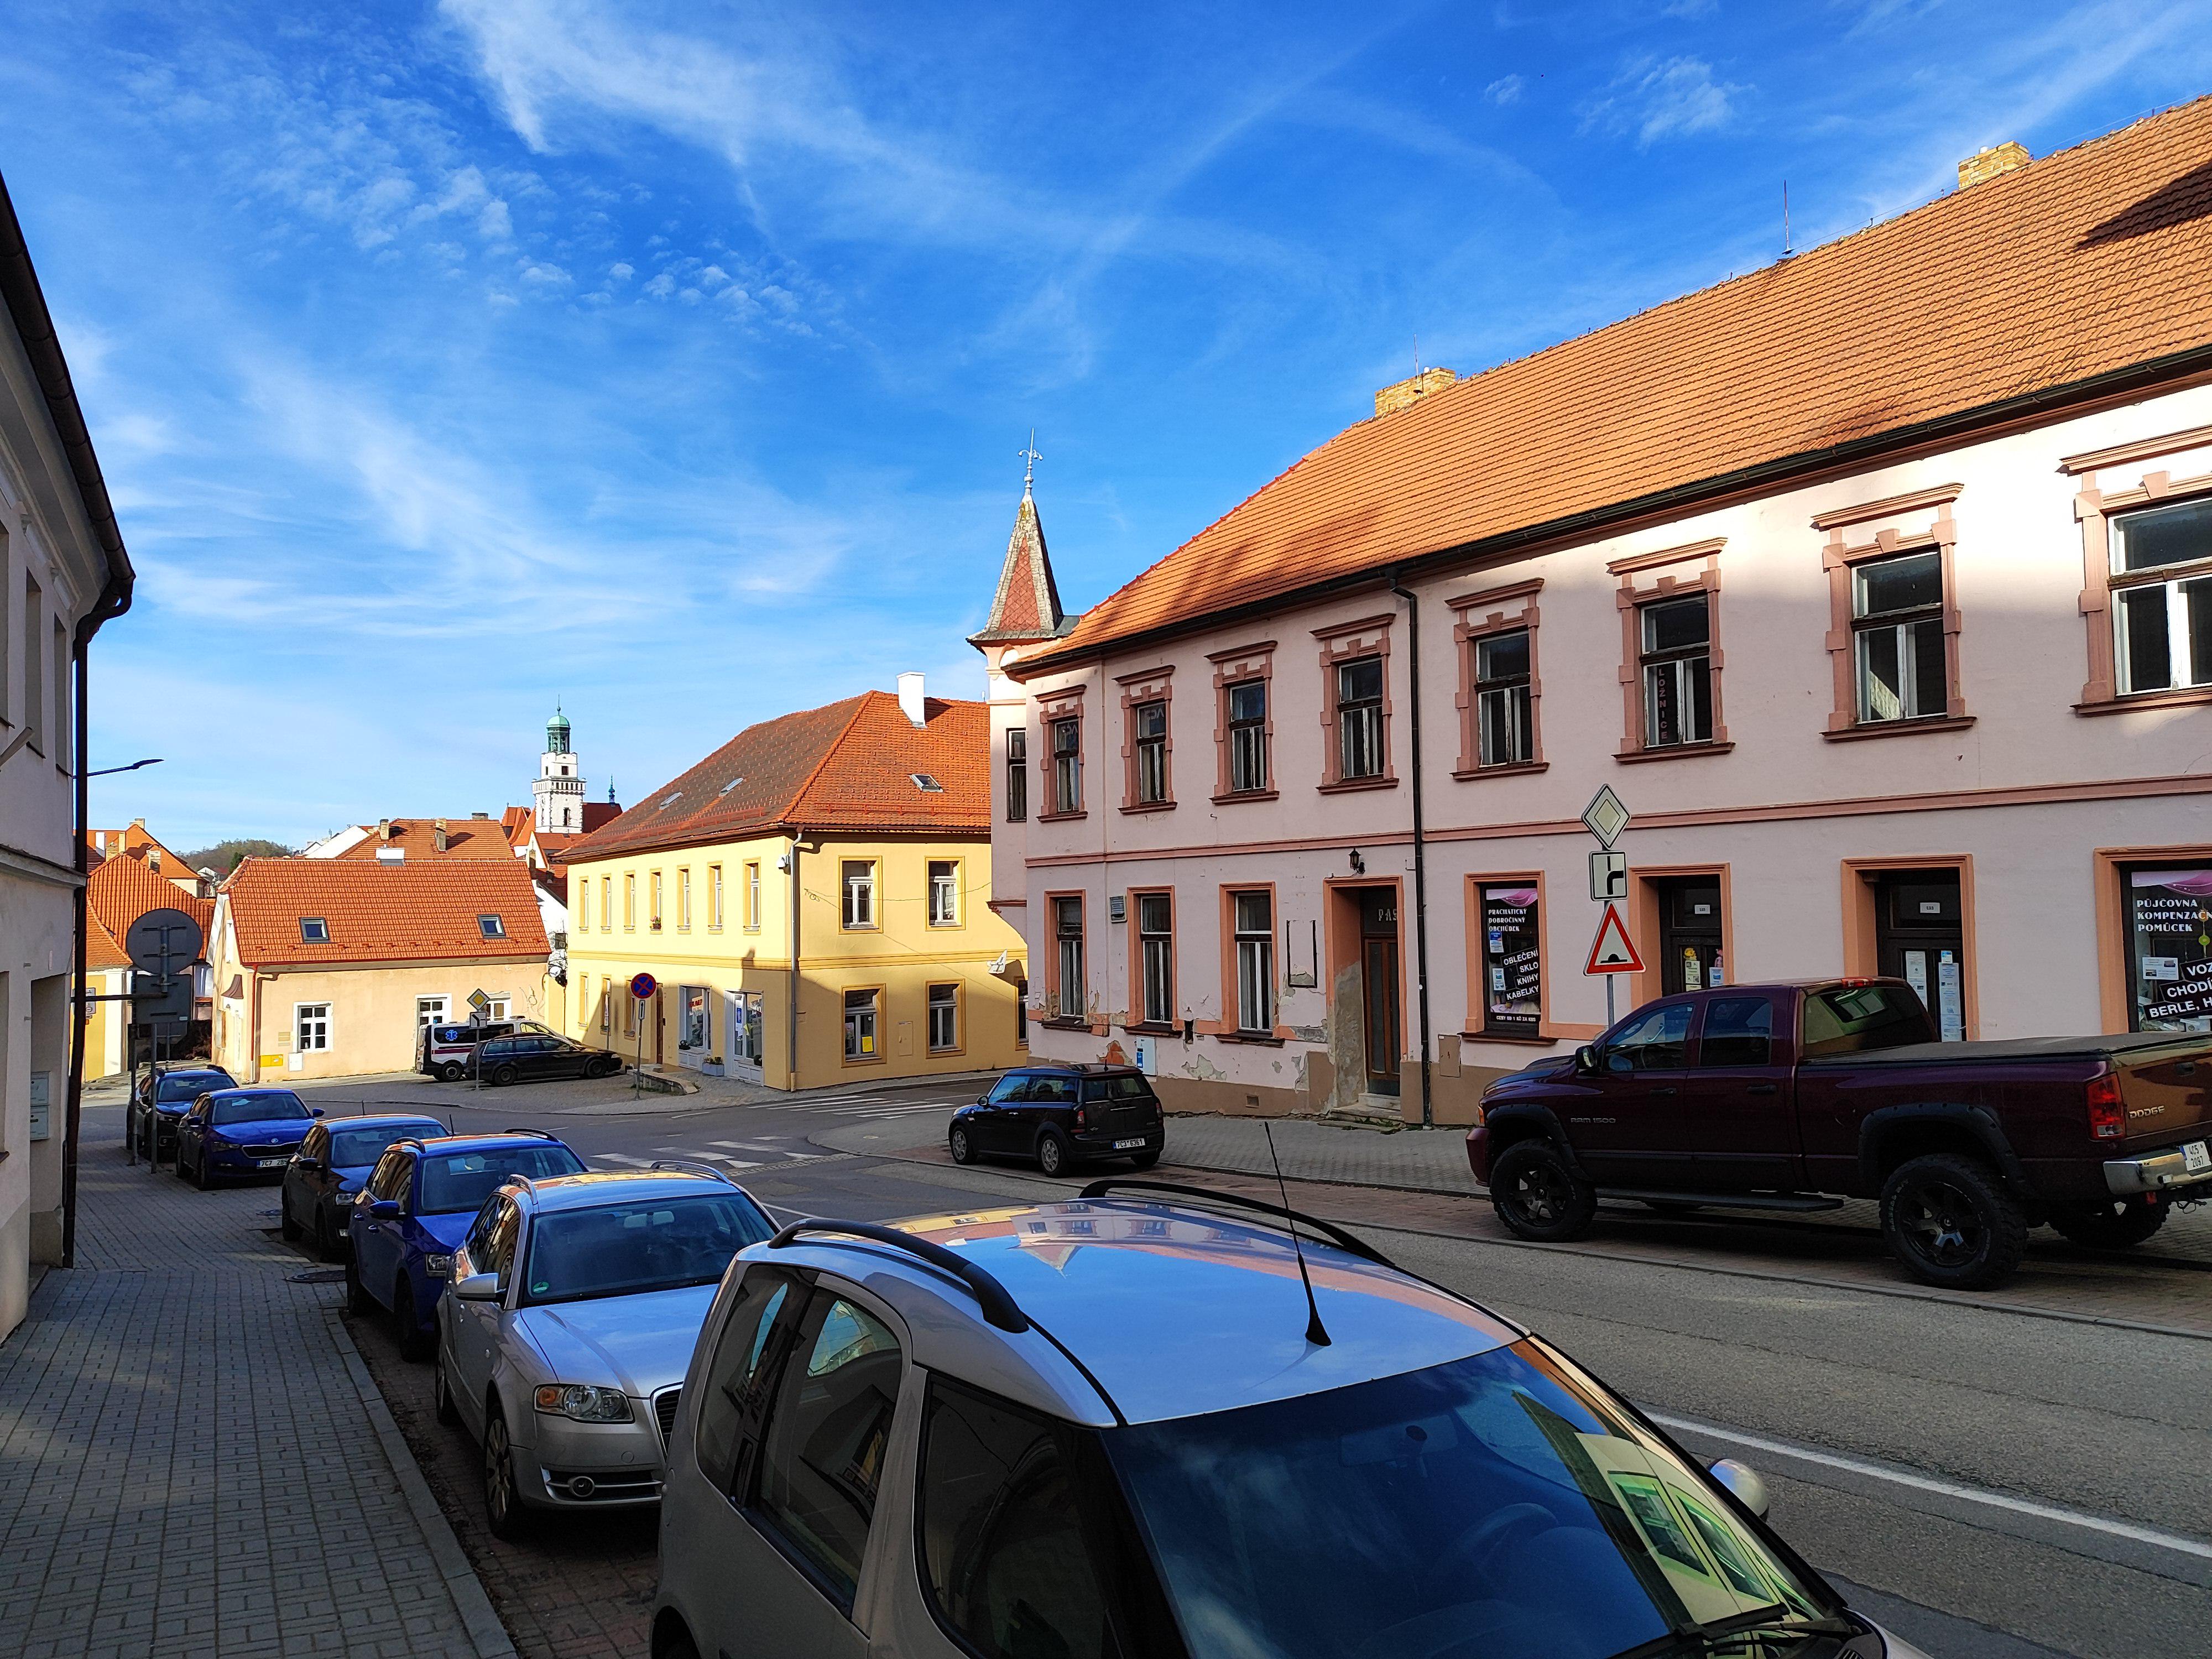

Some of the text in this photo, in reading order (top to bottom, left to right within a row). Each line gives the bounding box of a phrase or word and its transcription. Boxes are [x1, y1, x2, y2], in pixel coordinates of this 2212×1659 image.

[1659, 668, 1668, 739] LOŽNICE
[2136, 898, 2198, 907] PŮJČOVNA
[2138, 922, 2193, 932] POMŮCEK
[1504, 948, 1538, 966] OBLEČENÍ
[1519, 962, 1538, 973] SKLO
[1516, 973, 1538, 985] KNIHY
[1506, 985, 1539, 1000] KABELKY
[2167, 977, 2212, 998] CHODÍ
[2149, 1000, 2200, 1018] BERLE,
[2129, 1105, 2165, 1119] DODGE
